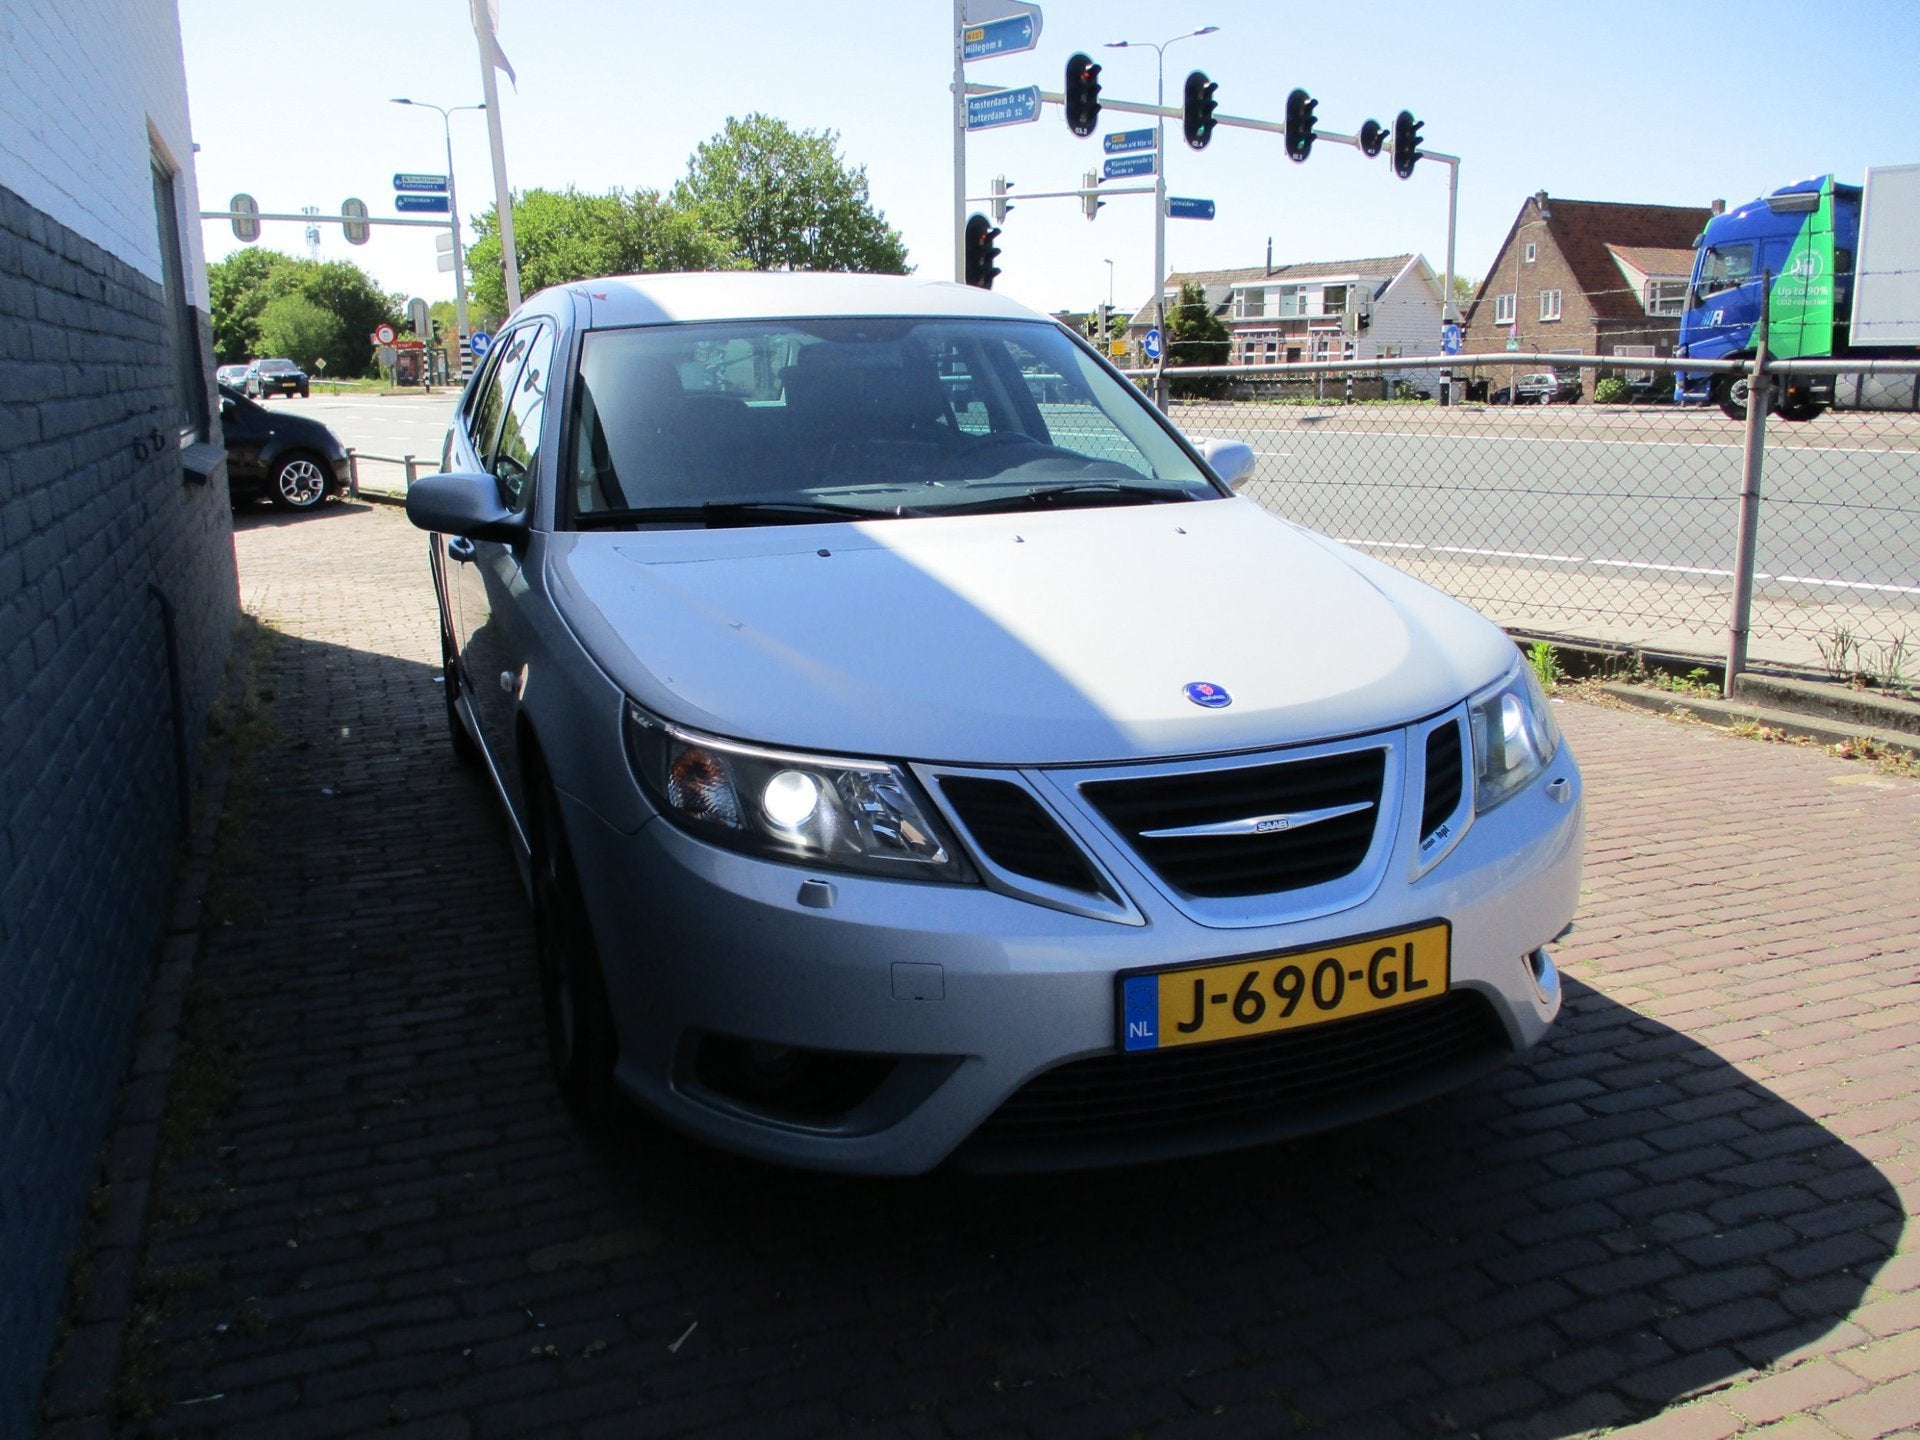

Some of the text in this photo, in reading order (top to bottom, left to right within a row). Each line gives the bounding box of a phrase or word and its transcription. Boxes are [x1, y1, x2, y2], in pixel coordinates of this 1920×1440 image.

[965, 42, 997, 54] Hillegom
[969, 97, 1008, 110] Amsterdam
[969, 111, 1005, 123] Rotterdam
[1777, 286, 1829, 297] Up to 90%
[1257, 819, 1289, 832] SAAB
[1176, 942, 1429, 1035] J-690-GL
[1129, 1020, 1154, 1038] NL
